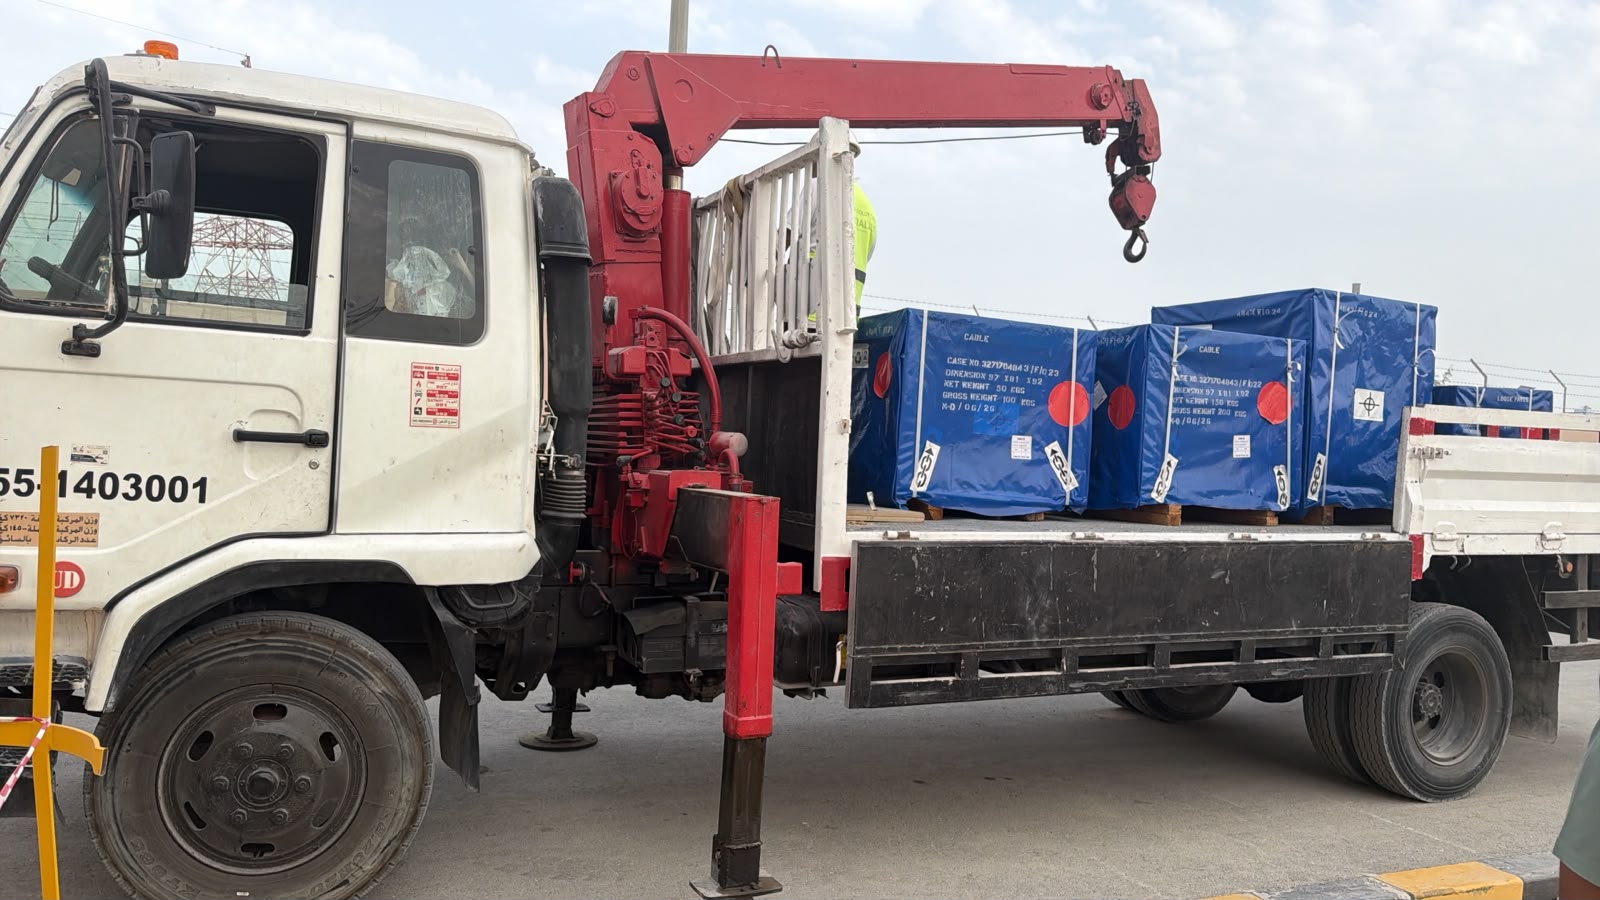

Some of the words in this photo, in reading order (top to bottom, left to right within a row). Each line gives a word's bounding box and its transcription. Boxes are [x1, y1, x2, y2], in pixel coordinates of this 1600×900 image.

[964, 333, 990, 343] CABLE
[1199, 346, 1221, 354] CABLE
[947, 357, 968, 366] CASE
[945, 369, 986, 380] DIMENSION
[943, 380, 959, 388] NET
[961, 381, 990, 391] WEIGHT
[1010, 386, 1025, 394] KGS
[942, 391, 968, 400] GROSS
[970, 392, 998, 402] WEIGHT
[1021, 398, 1036, 407] KGS
[1186, 397, 1208, 405] WEIGHT
[1211, 398, 1224, 406] 150
[1227, 399, 1239, 407] KGS
[1192, 407, 1216, 416] WEIGHT
[1218, 408, 1231, 416] 200
[56, 536, 79, 544] الركا
